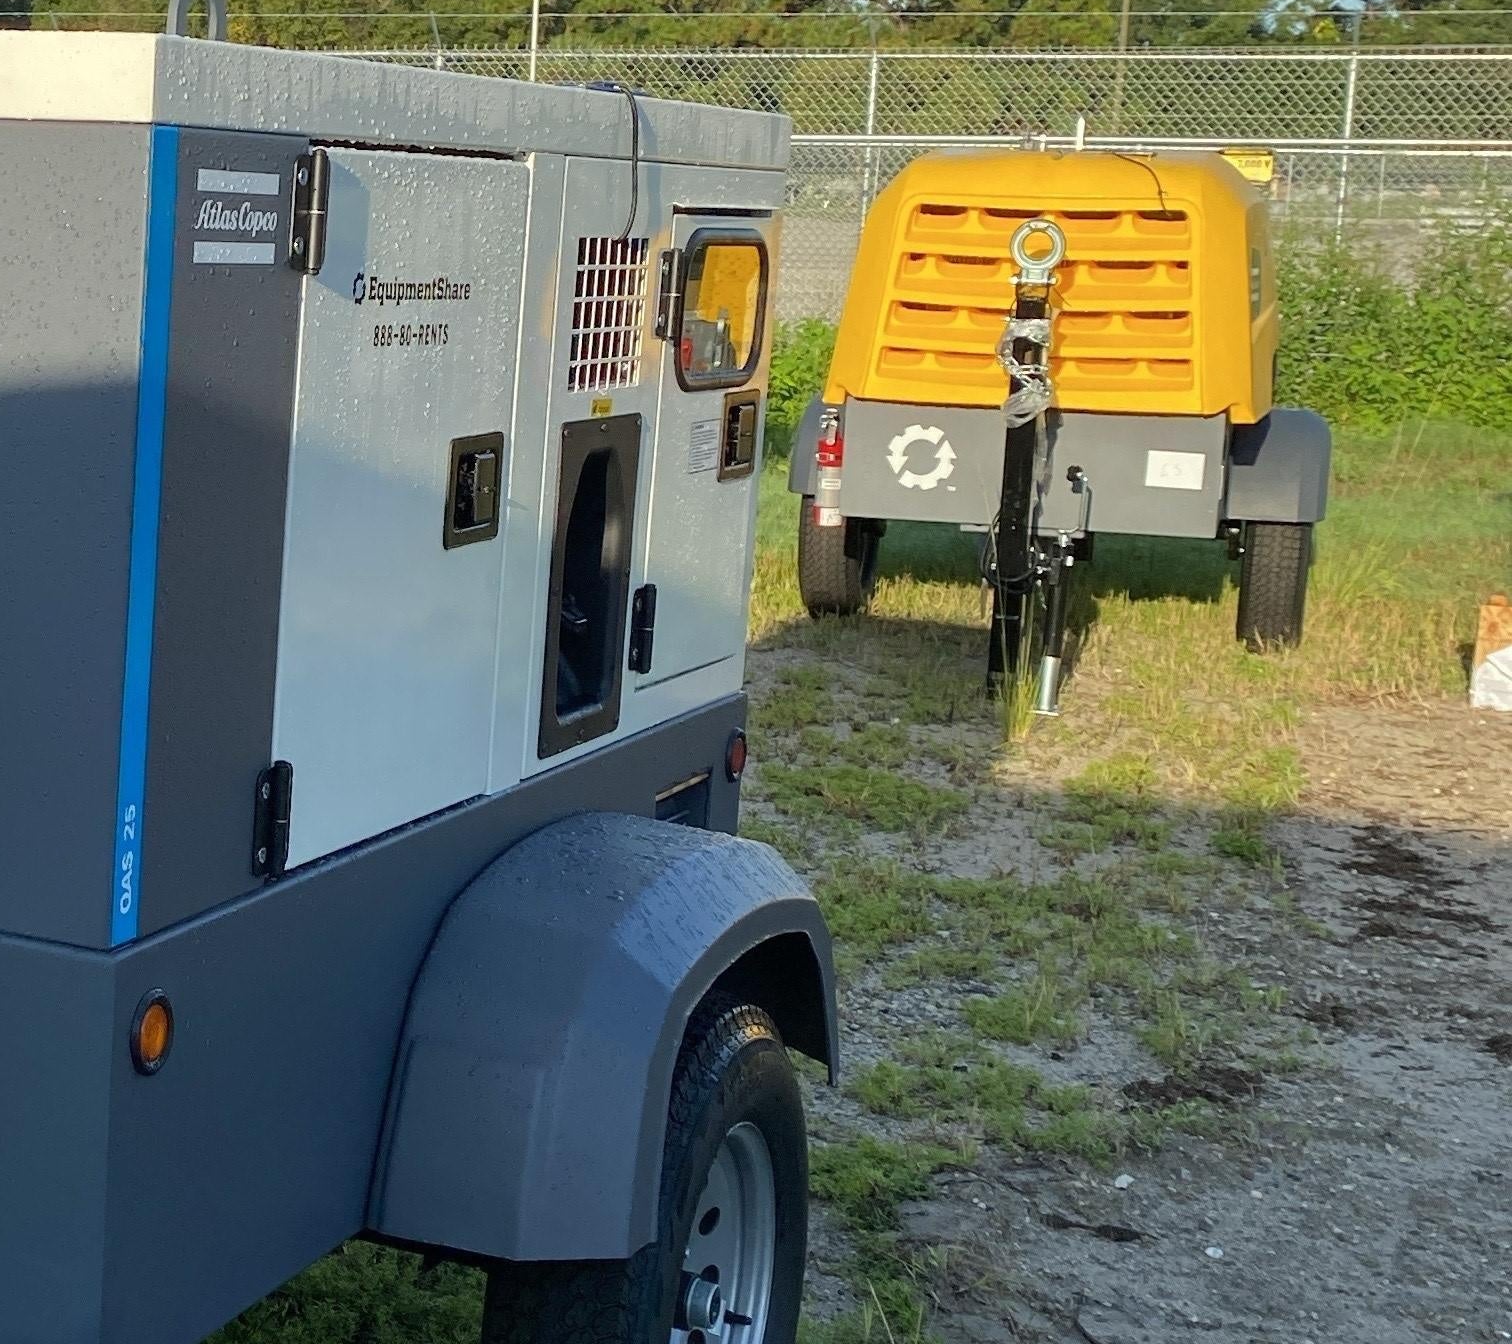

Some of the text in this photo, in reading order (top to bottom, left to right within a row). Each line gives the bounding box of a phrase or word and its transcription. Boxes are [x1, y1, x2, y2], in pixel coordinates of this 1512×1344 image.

[193, 200, 278, 238] Atlas Copco
[368, 276, 471, 306] EquipmentShare
[124, 804, 135, 840] 25
